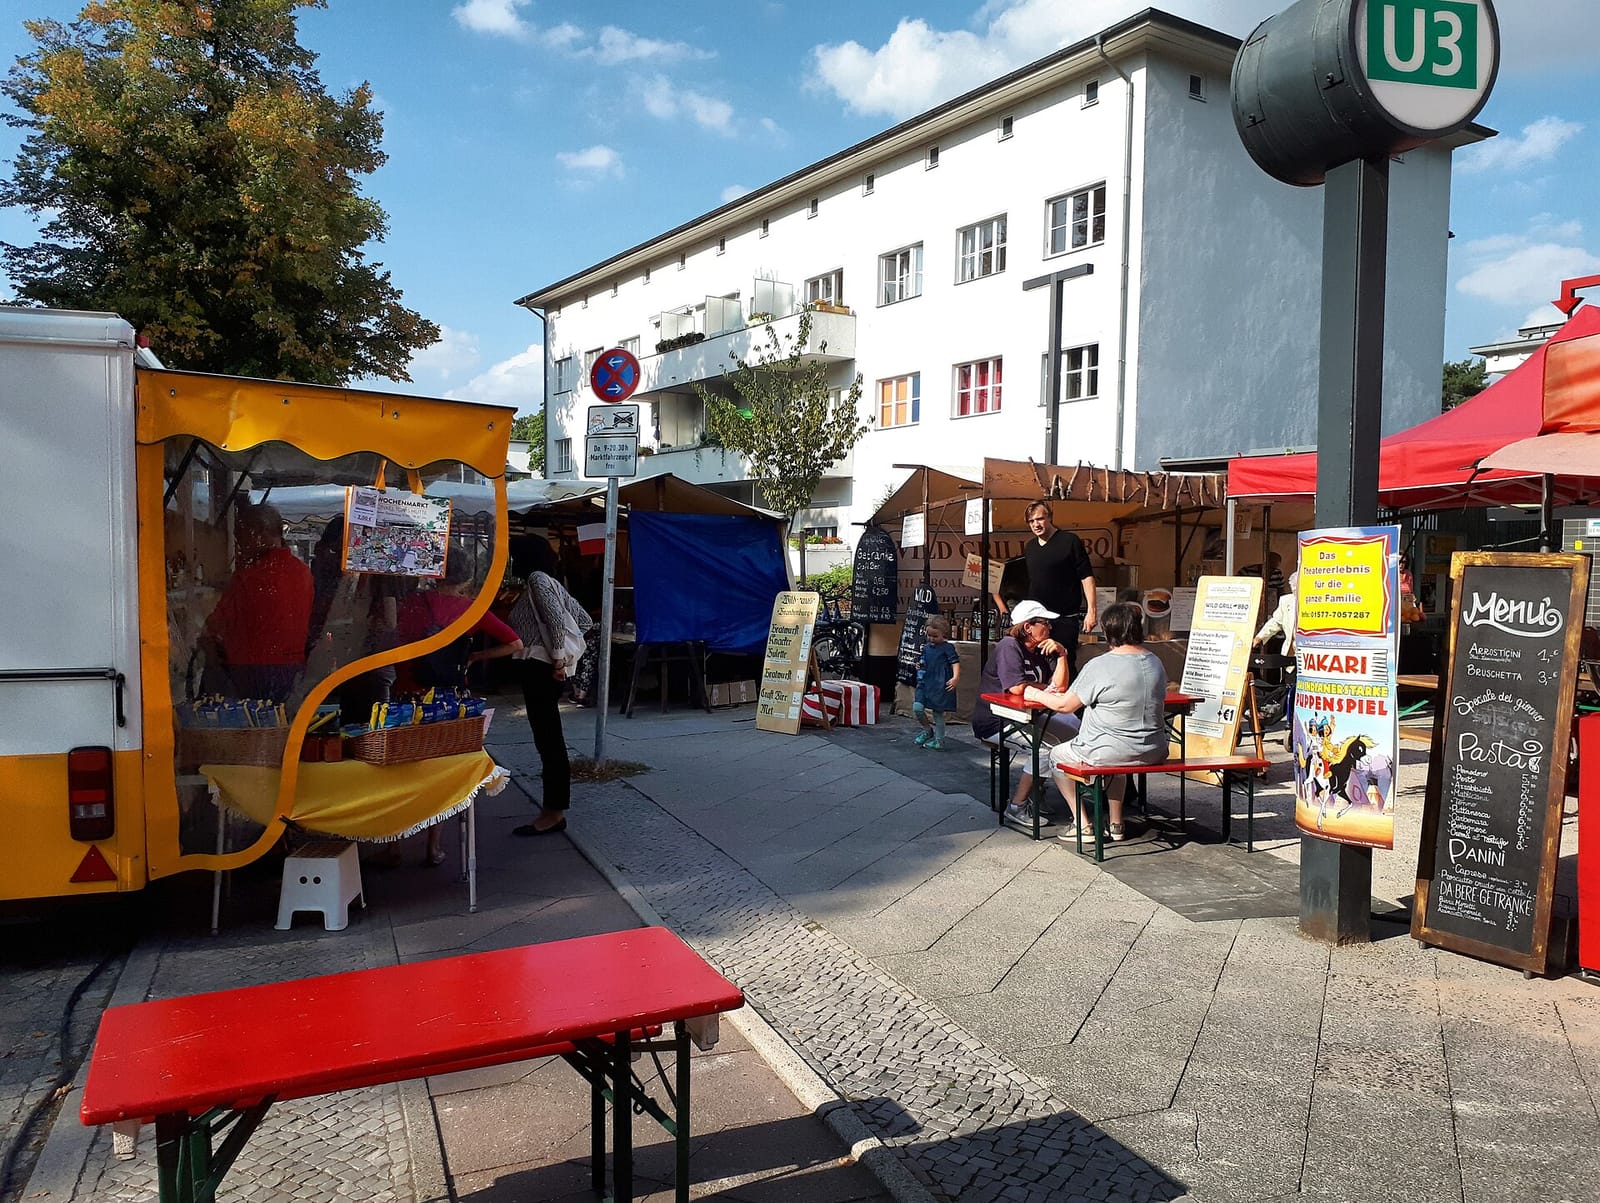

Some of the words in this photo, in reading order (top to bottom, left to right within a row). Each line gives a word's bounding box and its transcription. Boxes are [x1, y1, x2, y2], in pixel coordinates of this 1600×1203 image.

[1383, 4, 1463, 77] U3
[605, 462, 616, 470] frei
[1319, 551, 1336, 560] Das
[1303, 565, 1370, 575] Theatererlebnis
[1315, 580, 1325, 588] für
[1327, 579, 1342, 588] die
[1305, 596, 1323, 604] ganze
[1325, 593, 1361, 603] Familie
[1302, 652, 1368, 675] YAKARI
[1467, 663, 1523, 681] BRUSCHETTA
[760, 703, 774, 715] Met
[1296, 692, 1388, 717] PUPPENSPIEL
[1453, 688, 1497, 716] Speciale
[1498, 691, 1514, 704] del
[1513, 698, 1545, 722] giorno
[1458, 732, 1543, 770] Pasta
[1448, 838, 1506, 867] PANINI
[1440, 880, 1454, 898] DA
[1455, 883, 1478, 903] BERE
[1479, 888, 1532, 917] GETRÄNKE
